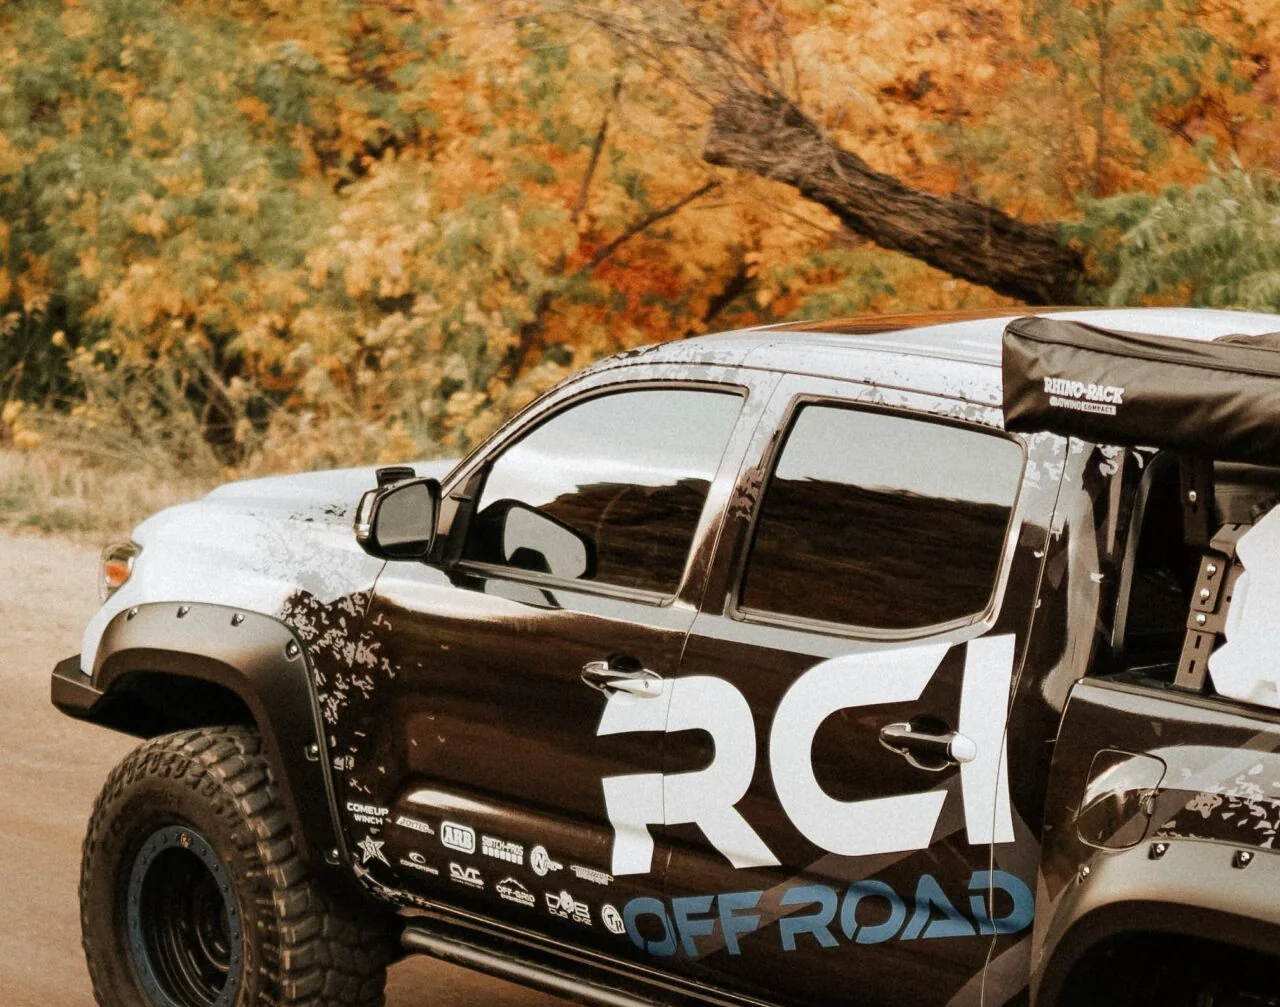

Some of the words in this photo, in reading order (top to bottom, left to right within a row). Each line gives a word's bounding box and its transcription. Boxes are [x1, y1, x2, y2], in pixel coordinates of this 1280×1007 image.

[1044, 376, 1125, 404] RHINO-RACK
[1082, 401, 1116, 415] COMPACT
[597, 633, 1016, 876] RCI
[346, 802, 389, 816] COMEUP
[353, 813, 384, 826] WINCH
[444, 824, 473, 851] ARB
[496, 884, 536, 903] OFF-GRID
